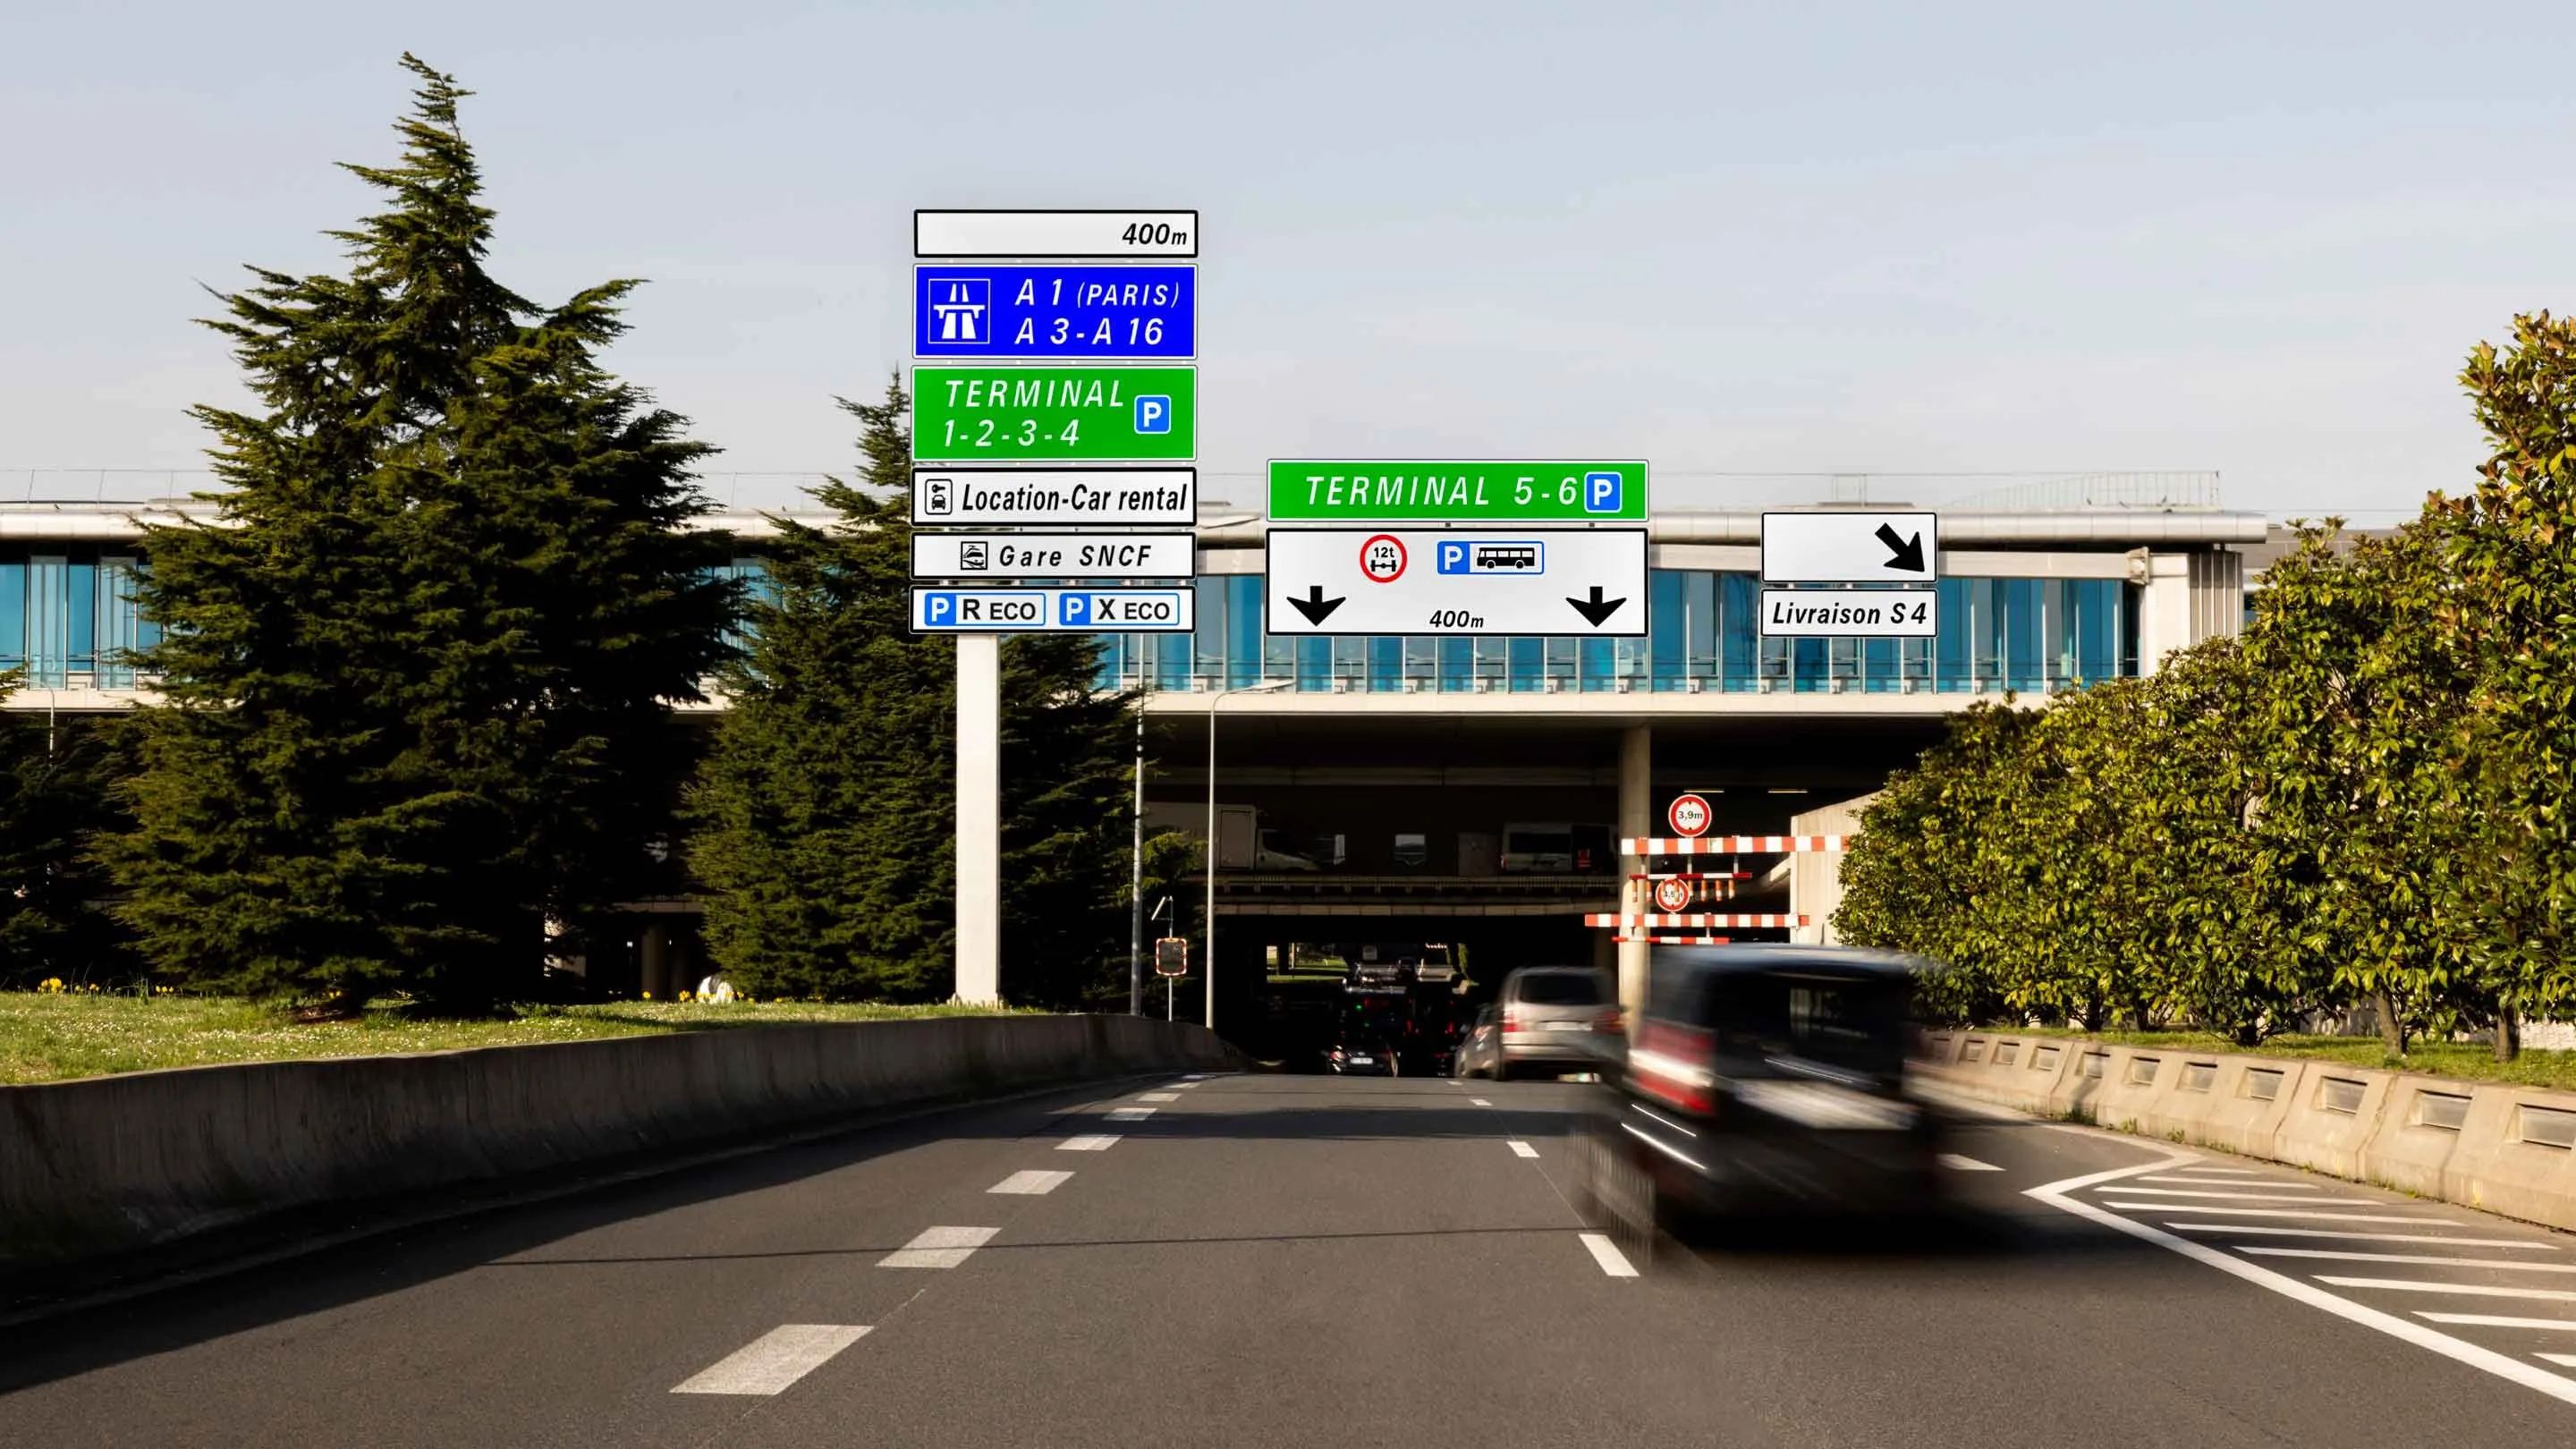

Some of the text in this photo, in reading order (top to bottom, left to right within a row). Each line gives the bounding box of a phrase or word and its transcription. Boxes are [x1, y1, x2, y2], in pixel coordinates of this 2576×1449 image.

[1122, 223, 1187, 245] 400m
[1014, 278, 1179, 308] A 1 (PARIS)
[1014, 318, 1035, 344] A
[1129, 318, 1164, 344] 16
[945, 380, 1123, 408] TERMINAL
[1118, 483, 1188, 511] rental
[1306, 476, 1489, 505] TERMINAL
[999, 545, 1152, 567] Gare SNCF
[1373, 547, 1394, 559] 12t
[962, 598, 981, 621] R
[989, 602, 1037, 621] ECO
[1097, 598, 1116, 621] X
[1124, 602, 1170, 621] ECO
[1428, 609, 1484, 628] 400m
[1772, 601, 1881, 624] Livraison
[1677, 810, 1703, 820] 3,9m
